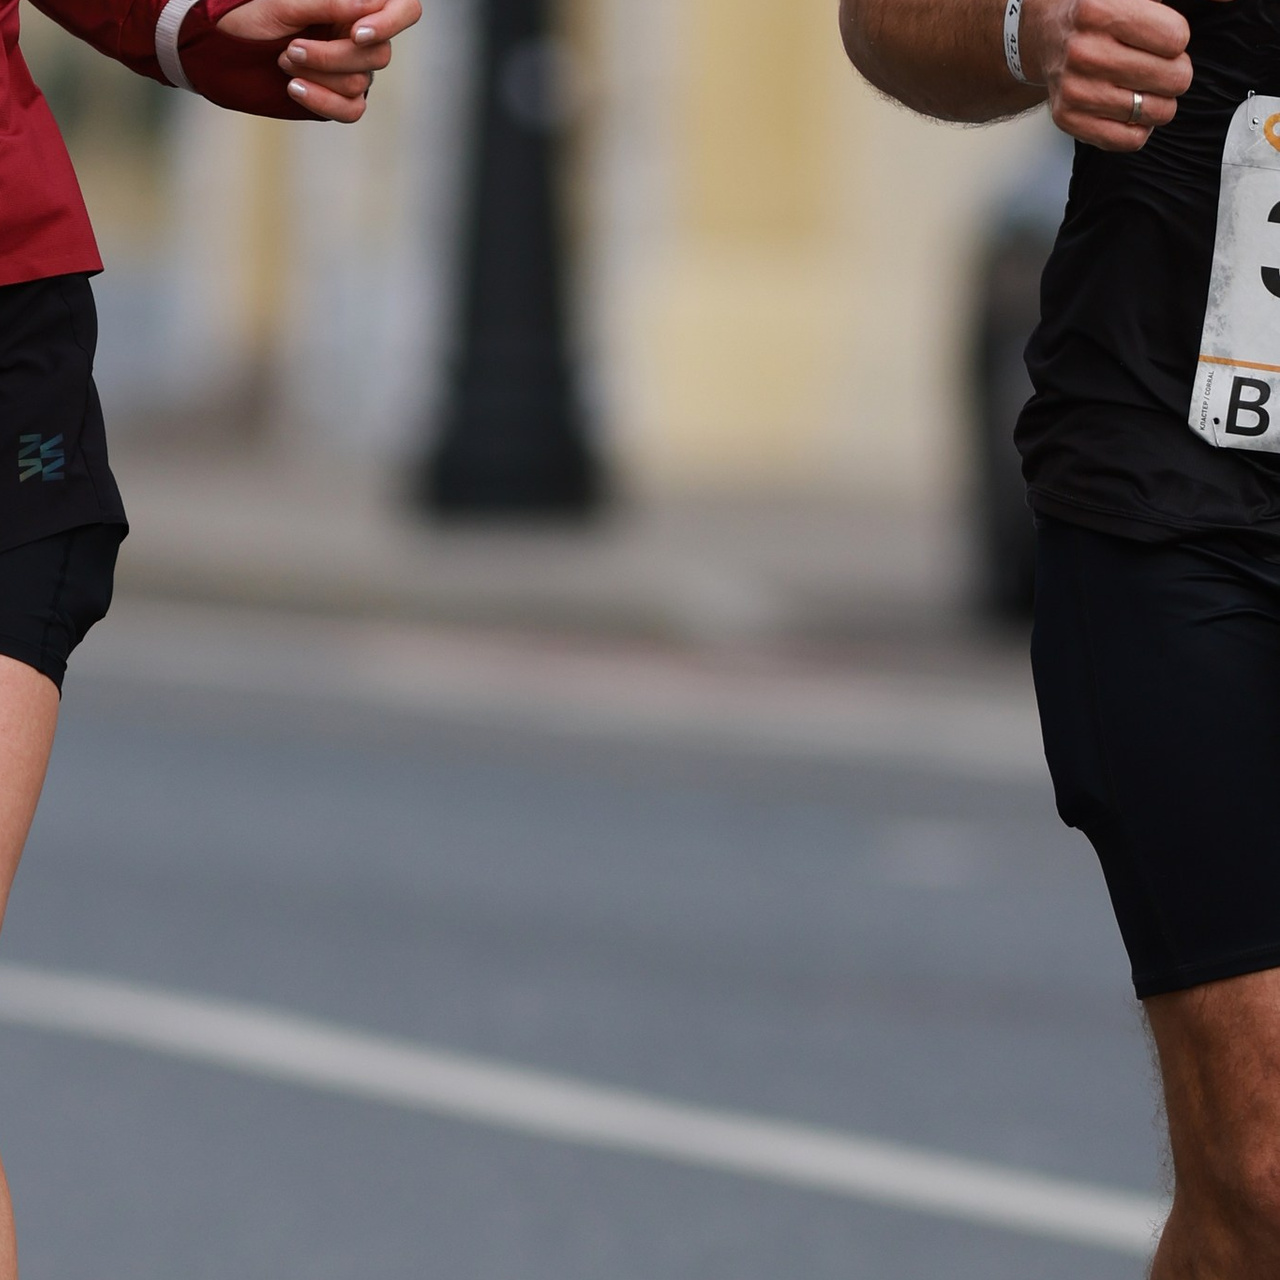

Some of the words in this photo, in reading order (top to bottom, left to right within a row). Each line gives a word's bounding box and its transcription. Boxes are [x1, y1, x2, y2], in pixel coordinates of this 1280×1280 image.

[1199, 401, 1209, 431] КЛАСТЕР
[1204, 371, 1215, 396] CORRAL
[1225, 376, 1271, 436] B
